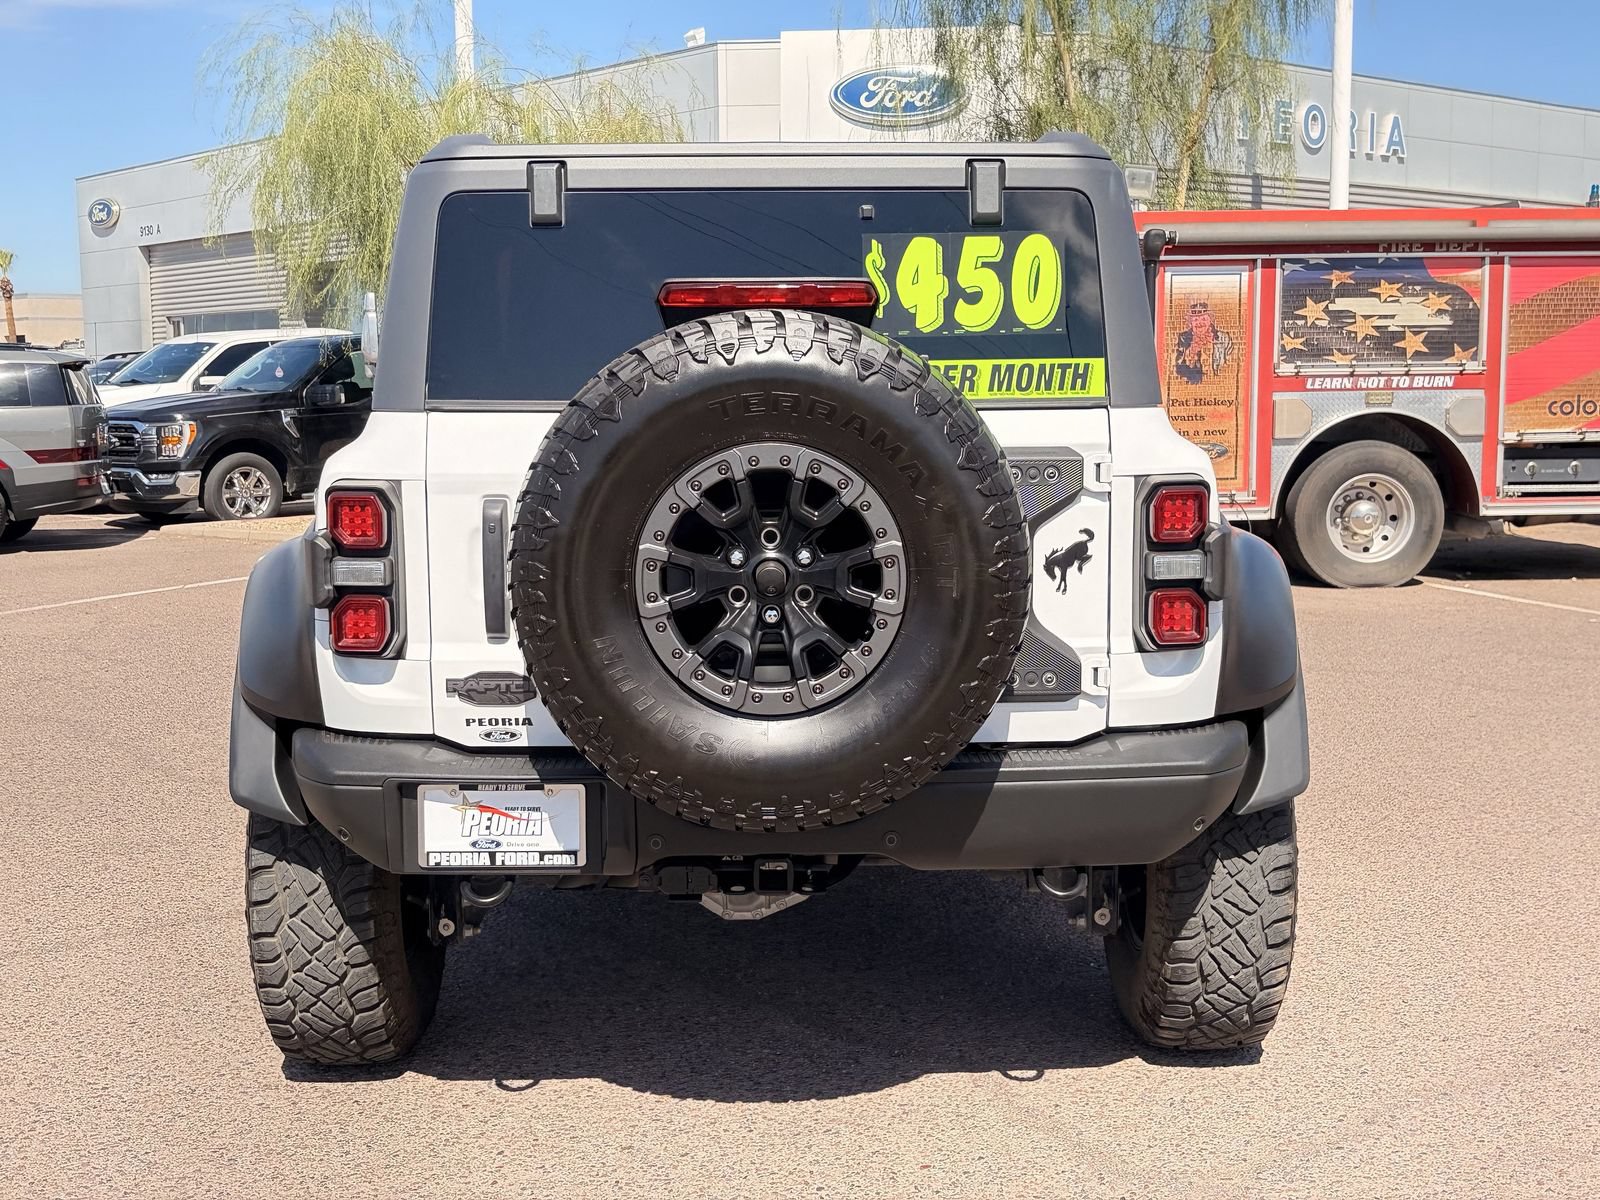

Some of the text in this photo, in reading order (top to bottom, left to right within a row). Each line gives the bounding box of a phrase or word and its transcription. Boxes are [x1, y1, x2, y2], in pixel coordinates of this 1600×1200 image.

[860, 76, 938, 108] Ford
[140, 223, 161, 237] 9130 A
[1378, 241, 1424, 252] FIRE
[865, 233, 1063, 333] $450
[988, 362, 1092, 394] MONTH
[1306, 375, 1455, 389] LEARN NOT TO BURN
[1170, 398, 1234, 408] Pat Hickey
[1548, 395, 1600, 416] colo
[1170, 413, 1206, 422] wants
[1179, 428, 1190, 436] in
[465, 717, 534, 727] PEORIA
[477, 783, 497, 791] READY
[461, 808, 543, 837] PEORIA
[429, 852, 576, 866] PEORIA FORD.com
